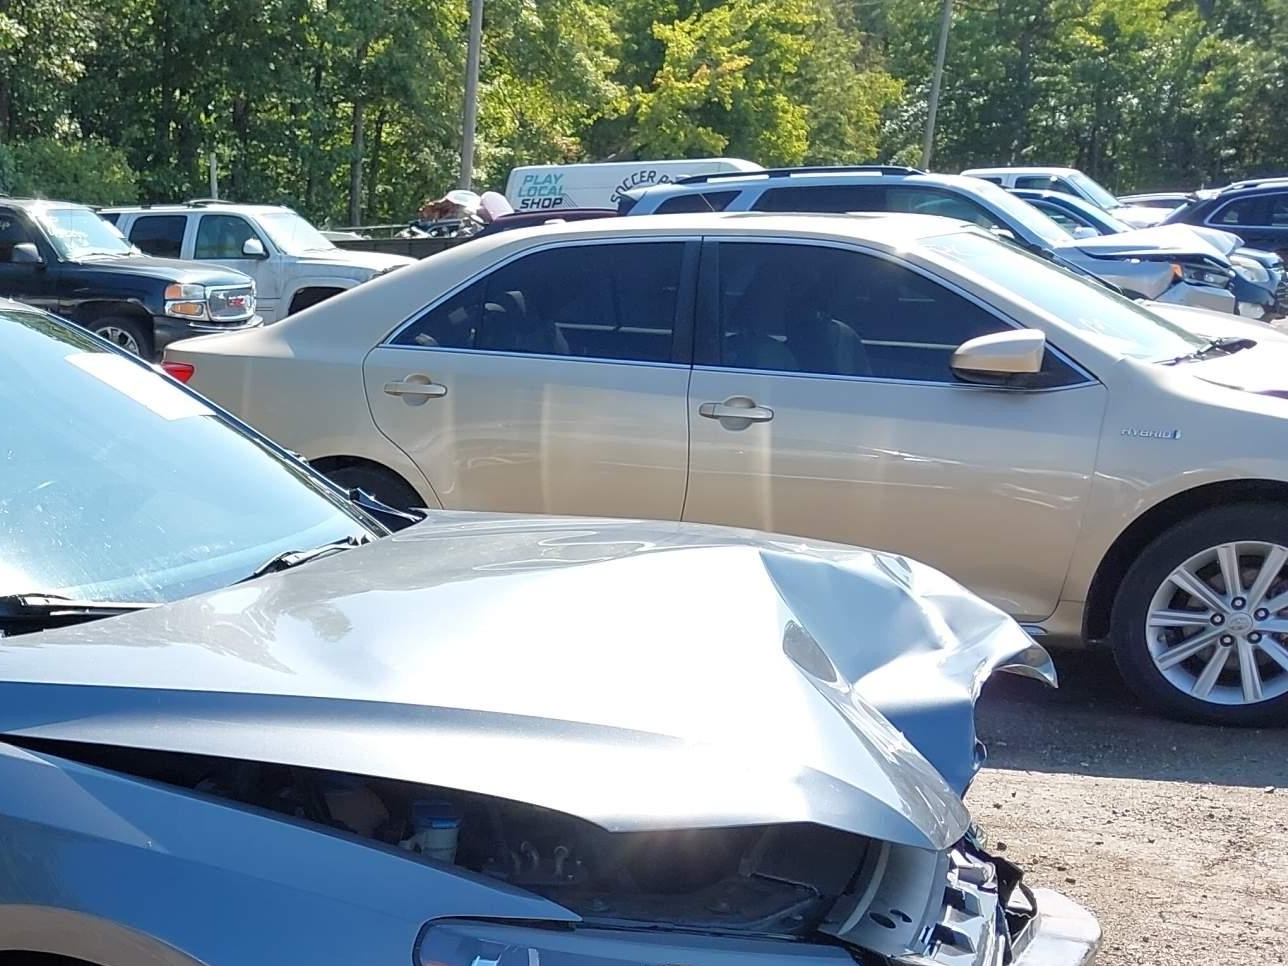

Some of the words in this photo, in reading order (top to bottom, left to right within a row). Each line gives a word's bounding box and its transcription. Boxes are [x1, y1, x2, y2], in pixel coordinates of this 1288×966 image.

[523, 173, 564, 185] PLAY
[518, 185, 565, 197] LOCAL
[610, 170, 657, 203] SOCCER
[520, 197, 563, 209] SHOP
